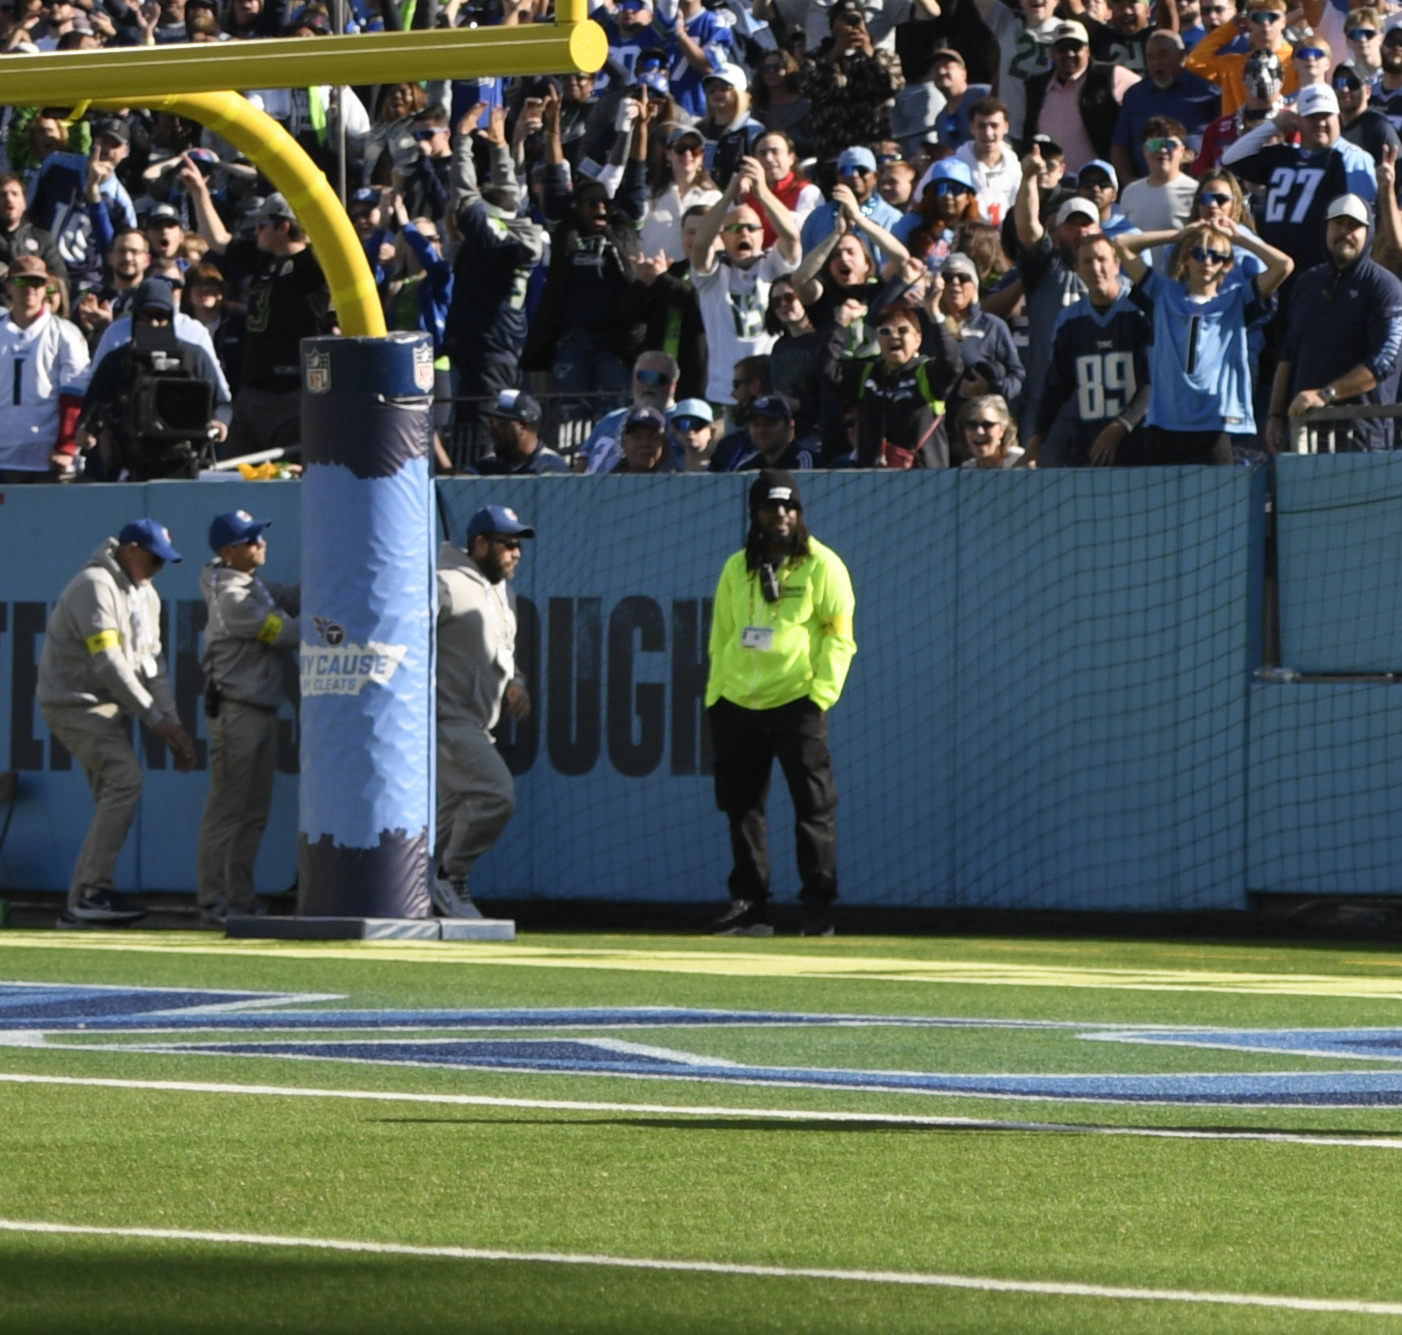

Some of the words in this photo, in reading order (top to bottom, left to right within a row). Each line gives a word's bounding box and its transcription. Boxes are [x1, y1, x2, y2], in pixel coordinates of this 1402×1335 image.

[1265, 166, 1327, 224] 27
[1077, 351, 1137, 422] 89
[314, 678, 357, 691] CLEATS
[316, 654, 389, 675] CAUSE
[496, 595, 718, 778] OUGH
